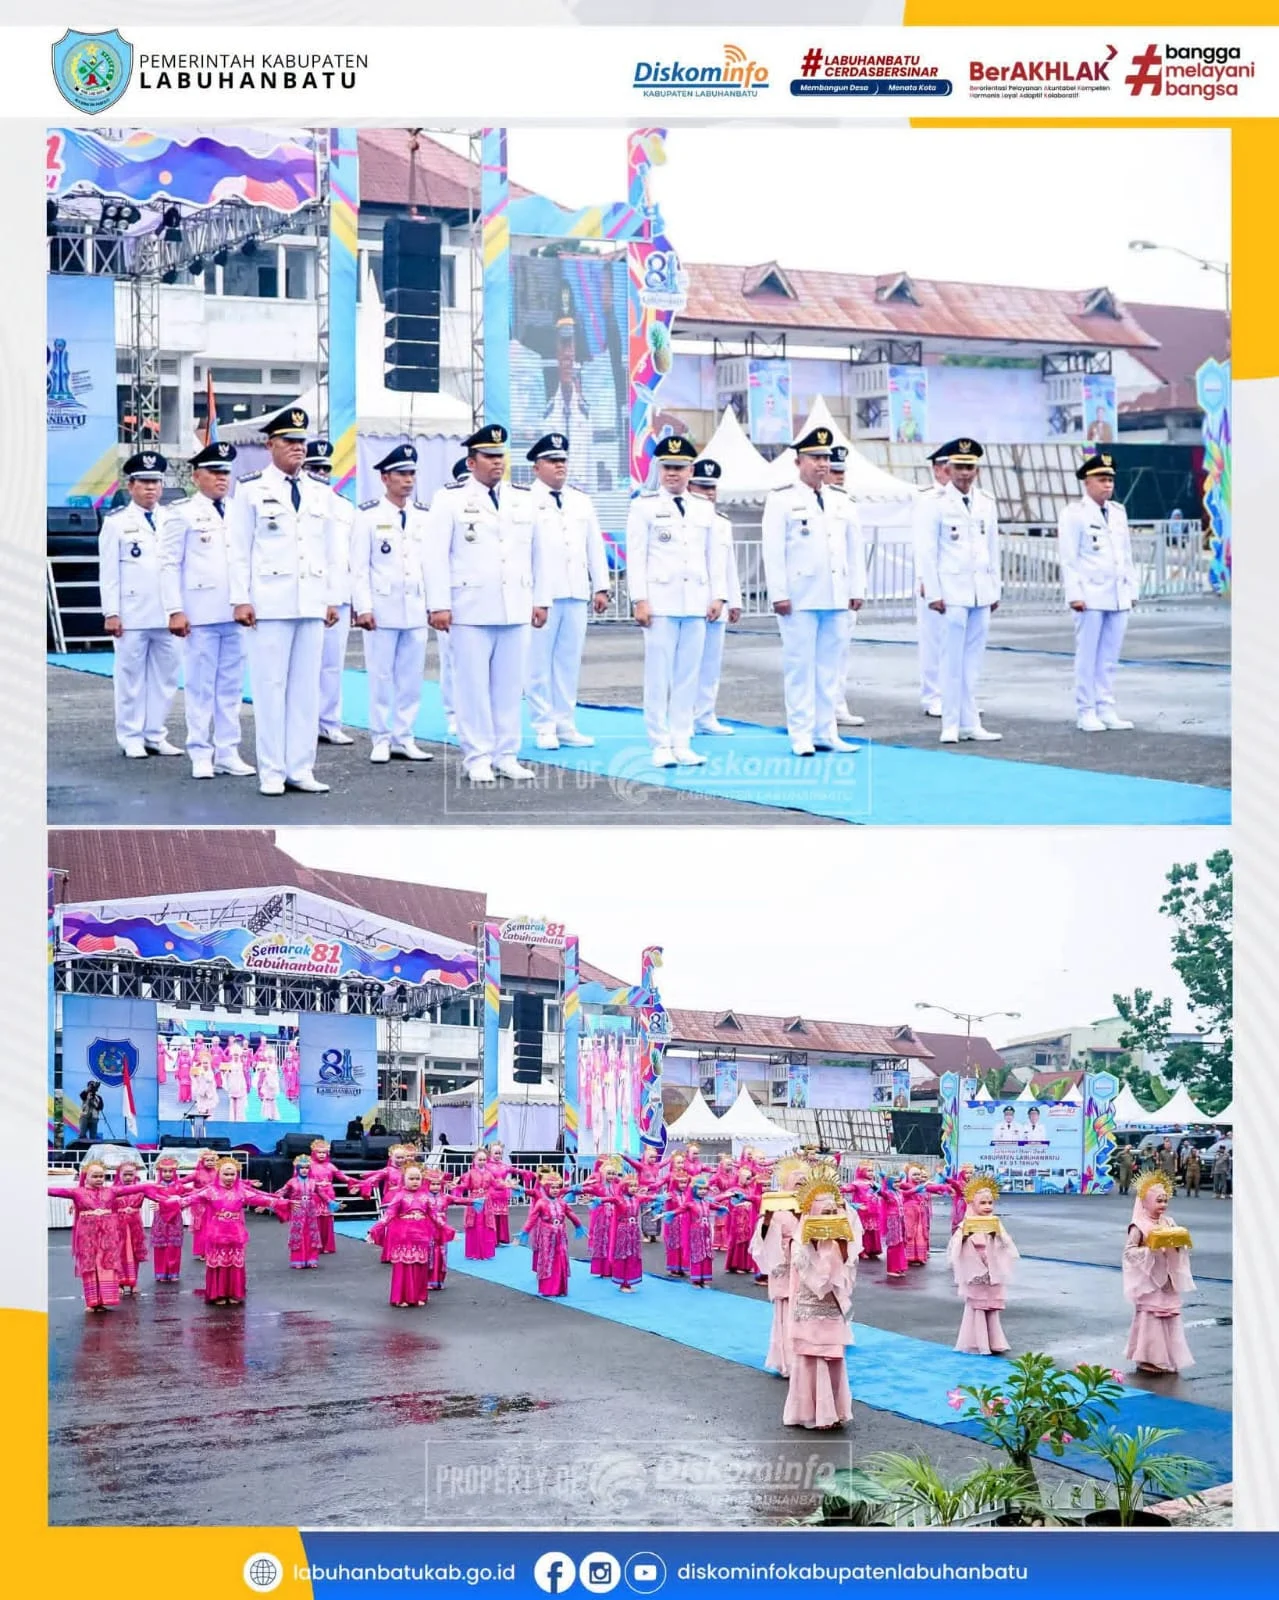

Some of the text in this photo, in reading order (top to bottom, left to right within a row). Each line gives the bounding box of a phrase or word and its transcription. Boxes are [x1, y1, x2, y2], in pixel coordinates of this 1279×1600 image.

[502, 931, 563, 945] Labuhanbatu
[506, 923, 565, 938] Semarak 81
[251, 943, 340, 964] Semarak 81
[246, 956, 338, 974] Labuhanbatu
